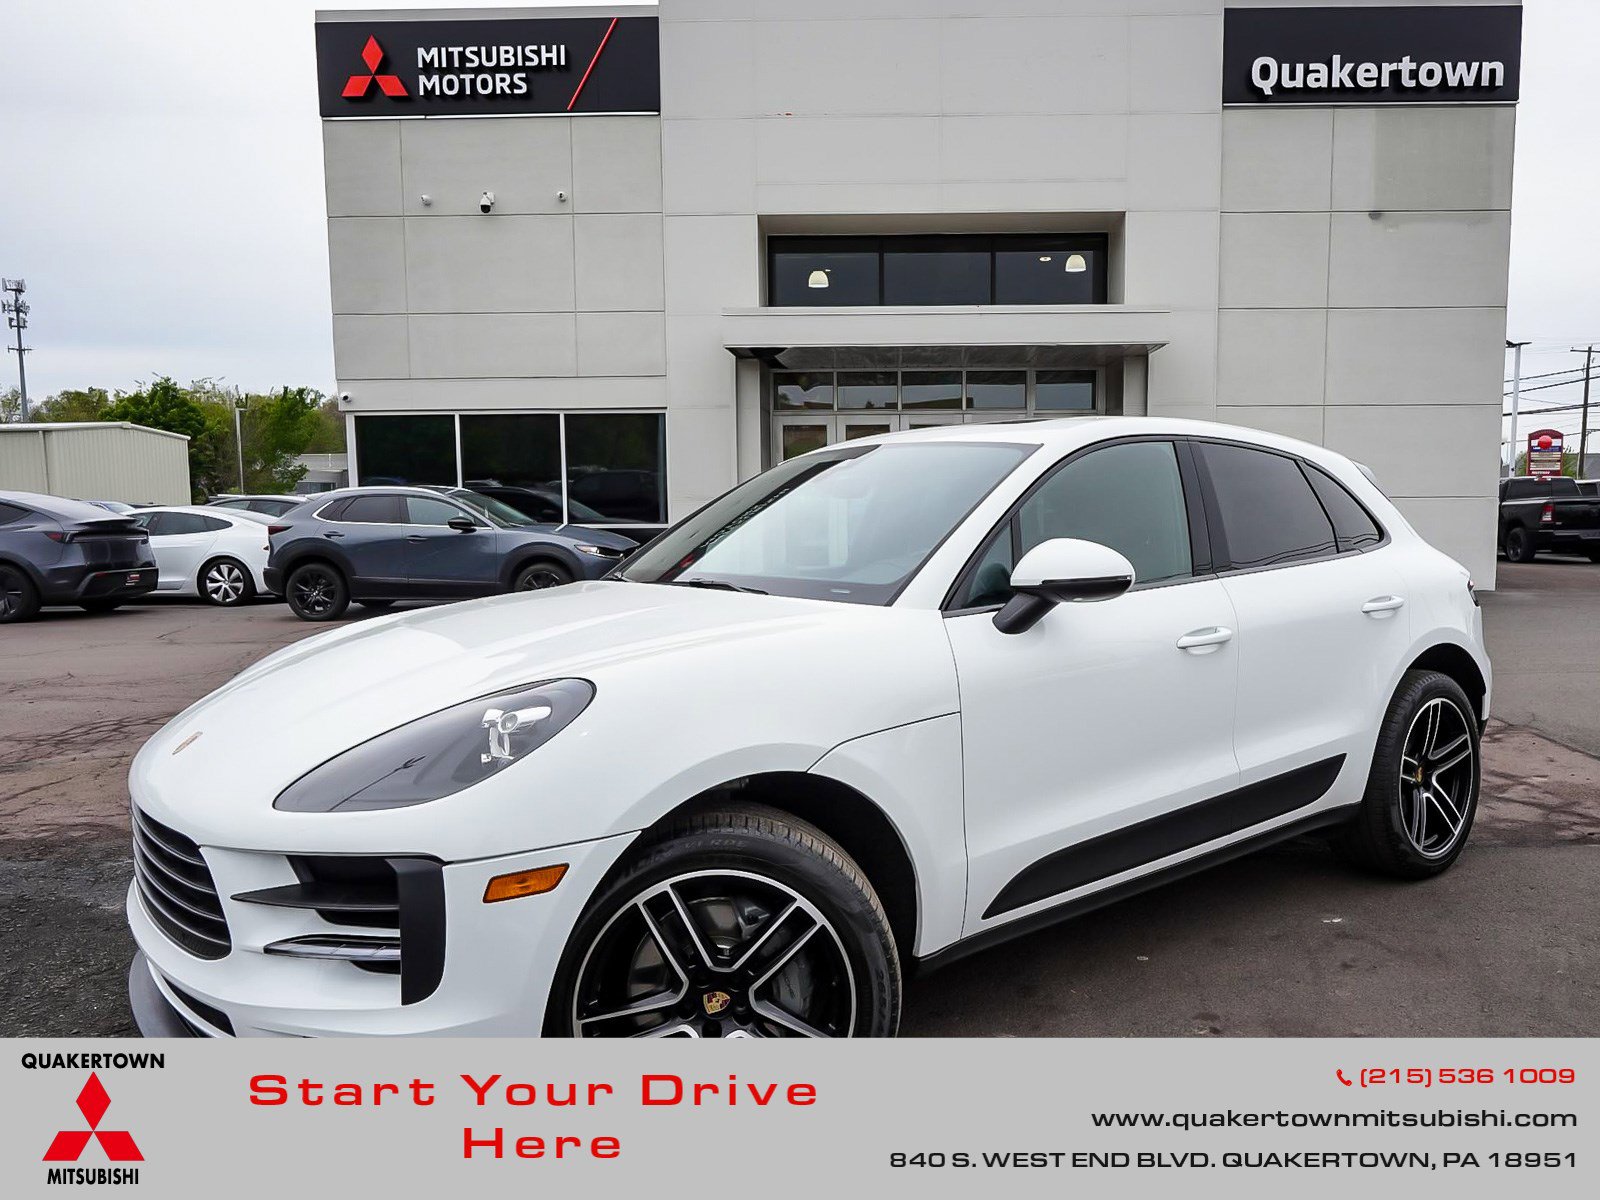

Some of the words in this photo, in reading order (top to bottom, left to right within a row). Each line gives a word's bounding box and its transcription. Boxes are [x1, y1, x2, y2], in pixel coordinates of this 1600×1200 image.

[418, 44, 567, 68] MITSUBISHI
[418, 73, 528, 96] MOTORS
[1251, 54, 1505, 96] Quakertown
